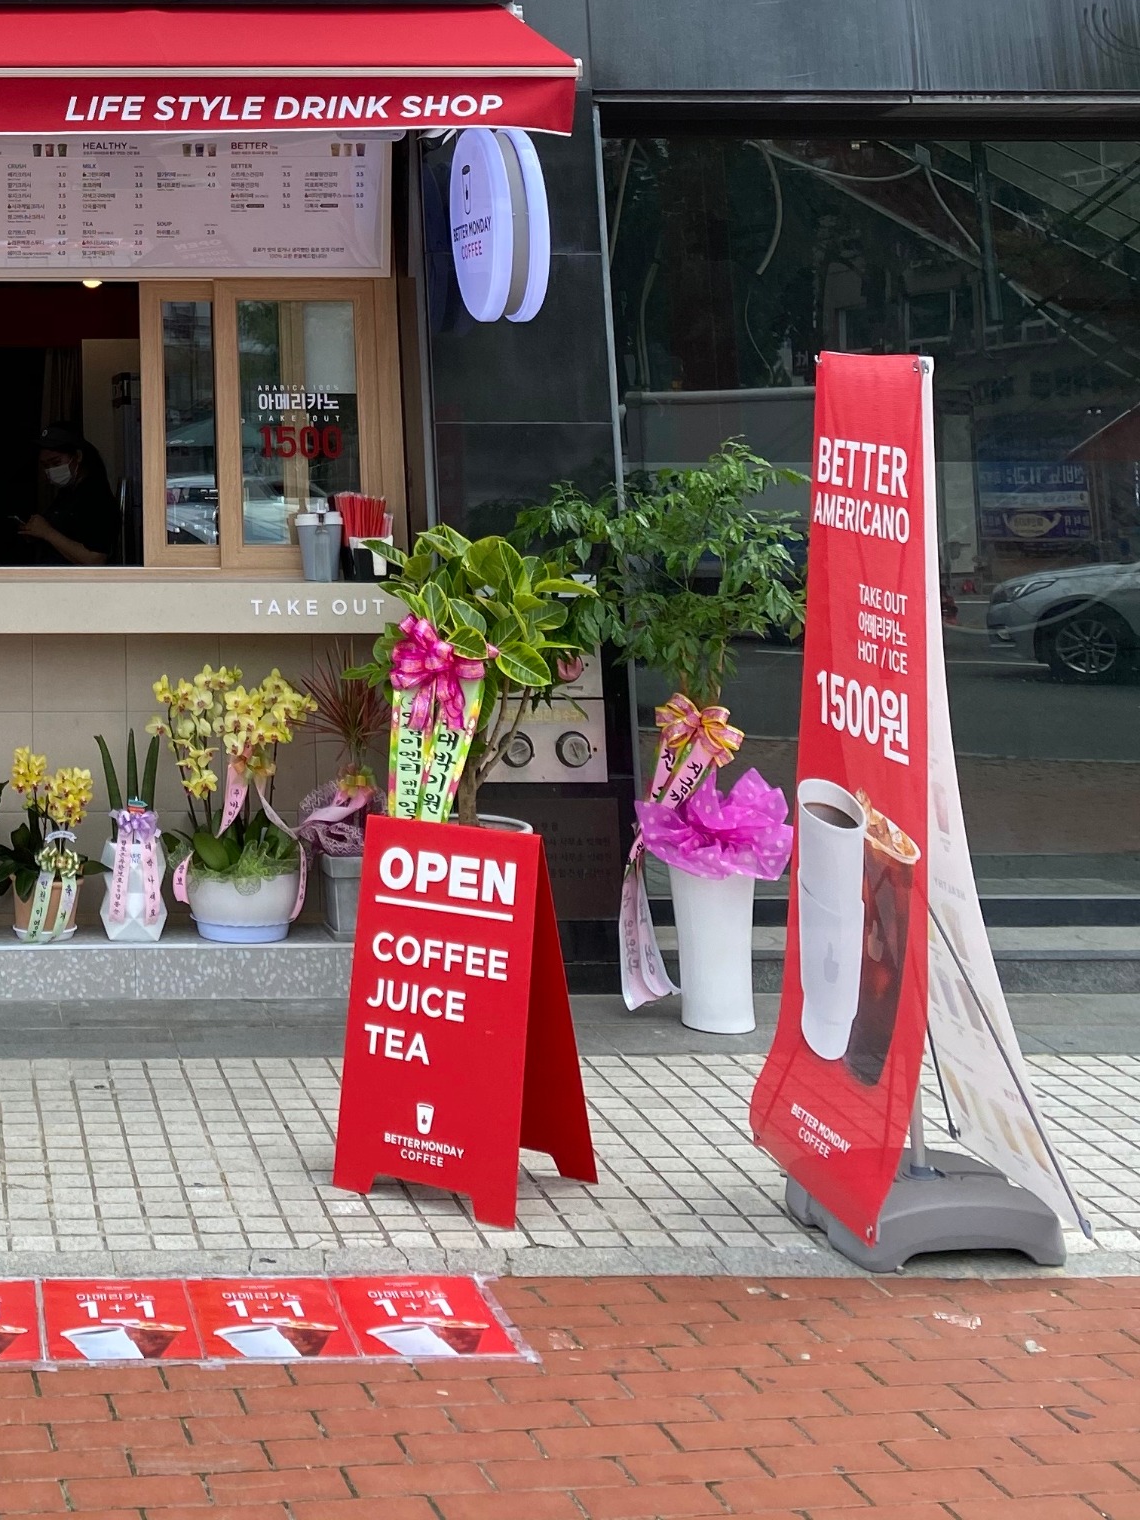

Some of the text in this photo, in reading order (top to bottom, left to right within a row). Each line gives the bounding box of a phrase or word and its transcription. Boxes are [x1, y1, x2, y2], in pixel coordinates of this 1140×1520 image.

[65, 93, 504, 122] LIFE STYLE DRINK SHOP
[453, 215, 492, 243] BETTER MONDAY
[461, 240, 483, 260] COFFEE
[257, 384, 306, 392] ARABICA
[258, 393, 340, 410] 아메리카노
[259, 425, 343, 460] 1500
[817, 436, 909, 499] BETTER
[813, 491, 910, 544] AMERICANO
[250, 598, 385, 616] TAKE OUT
[859, 583, 908, 616] TAKE OUT
[858, 611, 908, 647] 아메리카노
[857, 639, 879, 665] HOT
[888, 649, 908, 675] ICE
[816, 669, 910, 766] 1500원
[378, 846, 517, 906] OPEN
[372, 931, 510, 982] COFFEE
[366, 978, 467, 1023] JUICE
[363, 1023, 430, 1066] TEA
[790, 1102, 852, 1154] BETTER MONDAY
[798, 1126, 831, 1159] COFFEE
[384, 1131, 465, 1159] BETTER MONDAY
[400, 1148, 445, 1168] COFFEE
[76, 1292, 156, 1303] 아메리카노
[221, 1290, 301, 1301] 아메리카노
[367, 1289, 447, 1300] 아메리카노
